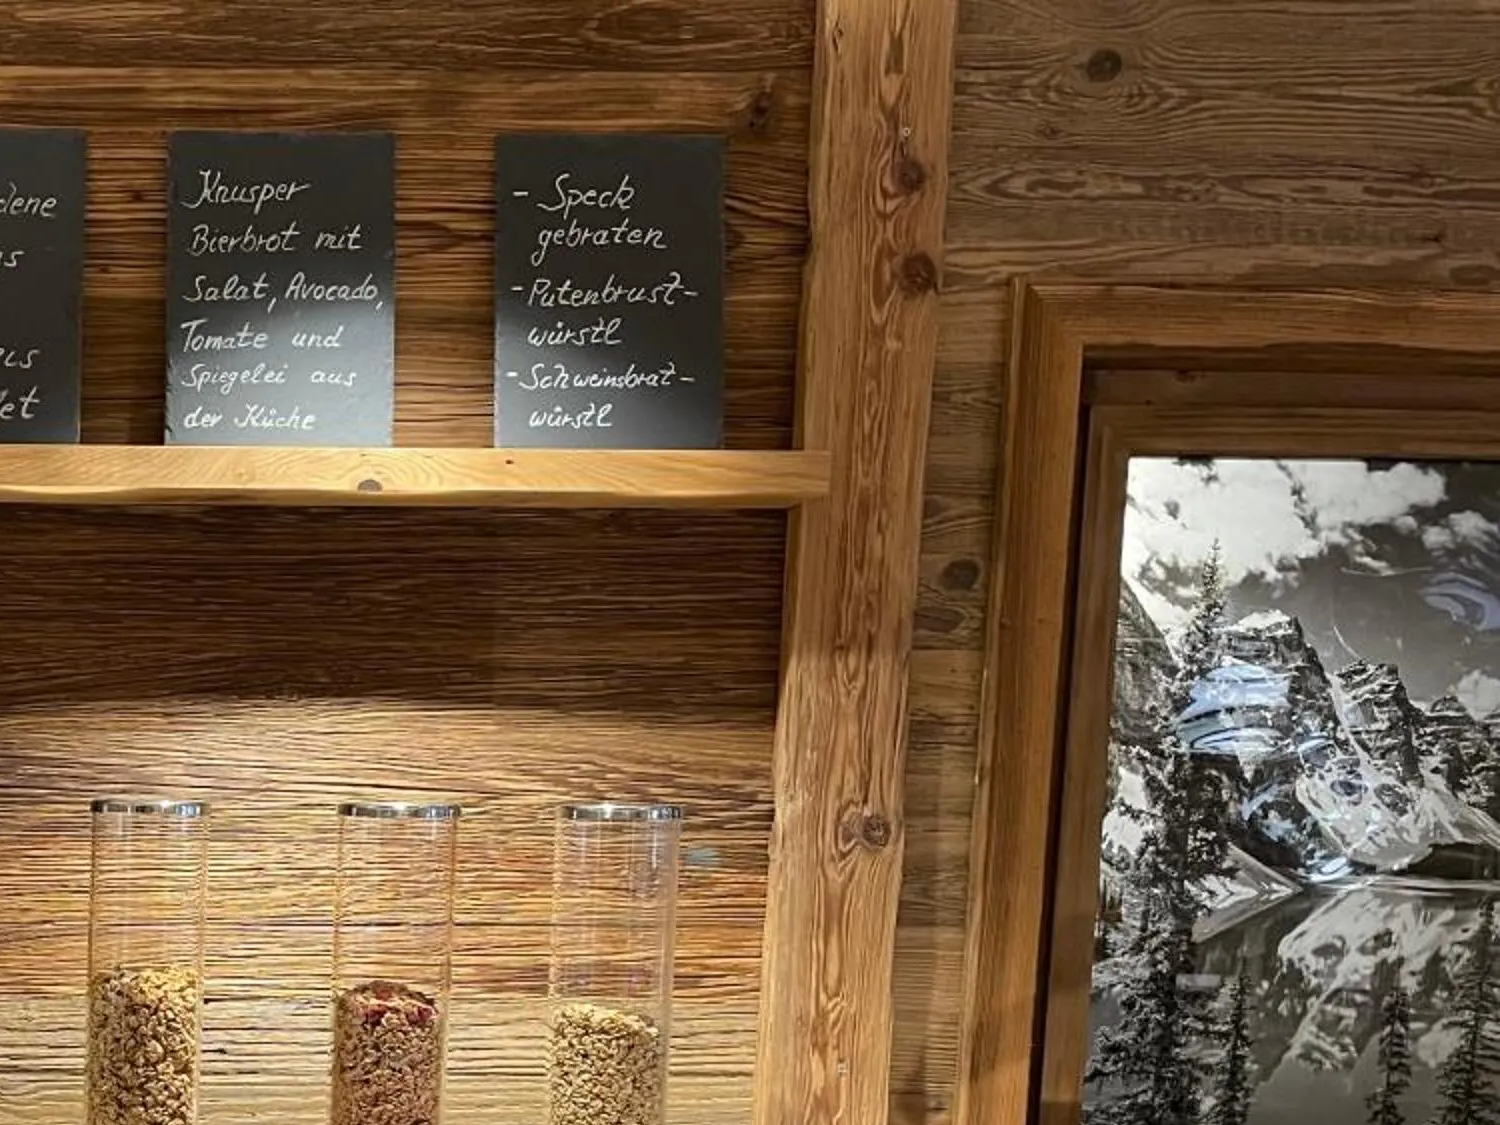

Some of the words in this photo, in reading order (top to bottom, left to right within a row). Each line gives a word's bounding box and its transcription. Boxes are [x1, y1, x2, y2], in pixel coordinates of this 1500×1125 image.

[180, 168, 312, 215] Knusper
[187, 221, 301, 257] Bierbrot
[315, 223, 363, 251] mit
[530, 217, 668, 267] gebraten
[182, 271, 278, 314] Salat,
[284, 271, 385, 312] Avocado,
[179, 317, 269, 353] Tomate
[290, 325, 344, 348] und
[527, 317, 624, 347] würstl
[180, 362, 290, 395] Spiegelei
[310, 369, 357, 387] aus
[182, 405, 224, 430] der
[233, 403, 317, 431] Küche
[528, 402, 614, 430] würstl
